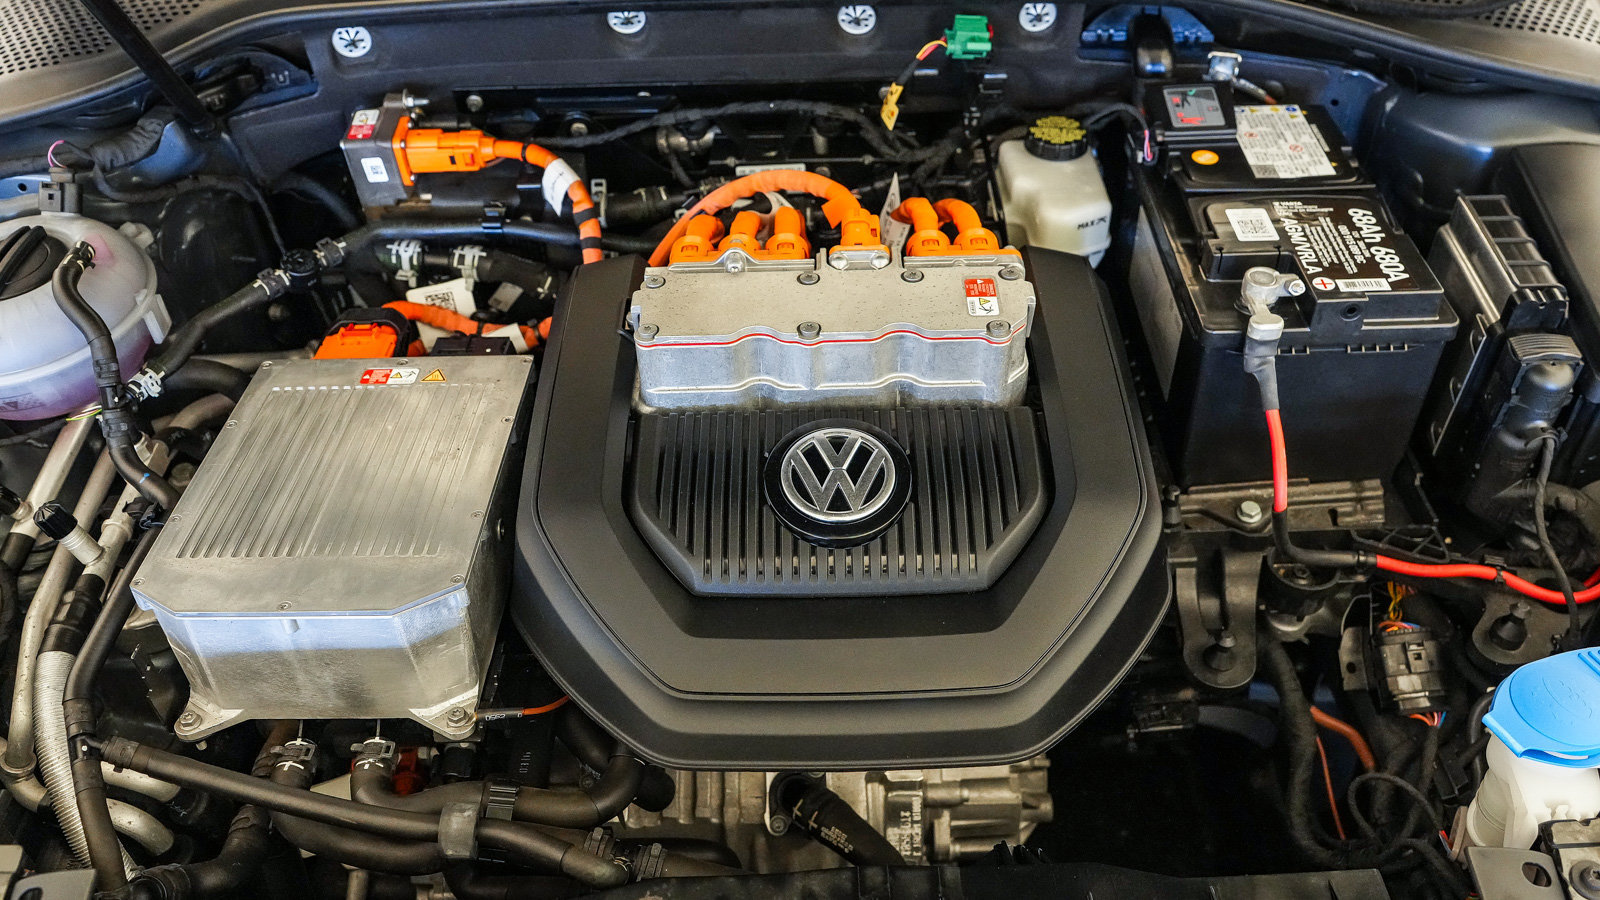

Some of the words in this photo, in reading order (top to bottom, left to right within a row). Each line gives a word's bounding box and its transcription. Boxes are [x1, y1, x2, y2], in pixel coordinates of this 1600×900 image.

[1280, 217, 1323, 275] AGM/VRLA
[1348, 208, 1385, 243] 68Ah
[1370, 246, 1410, 282] 680A
